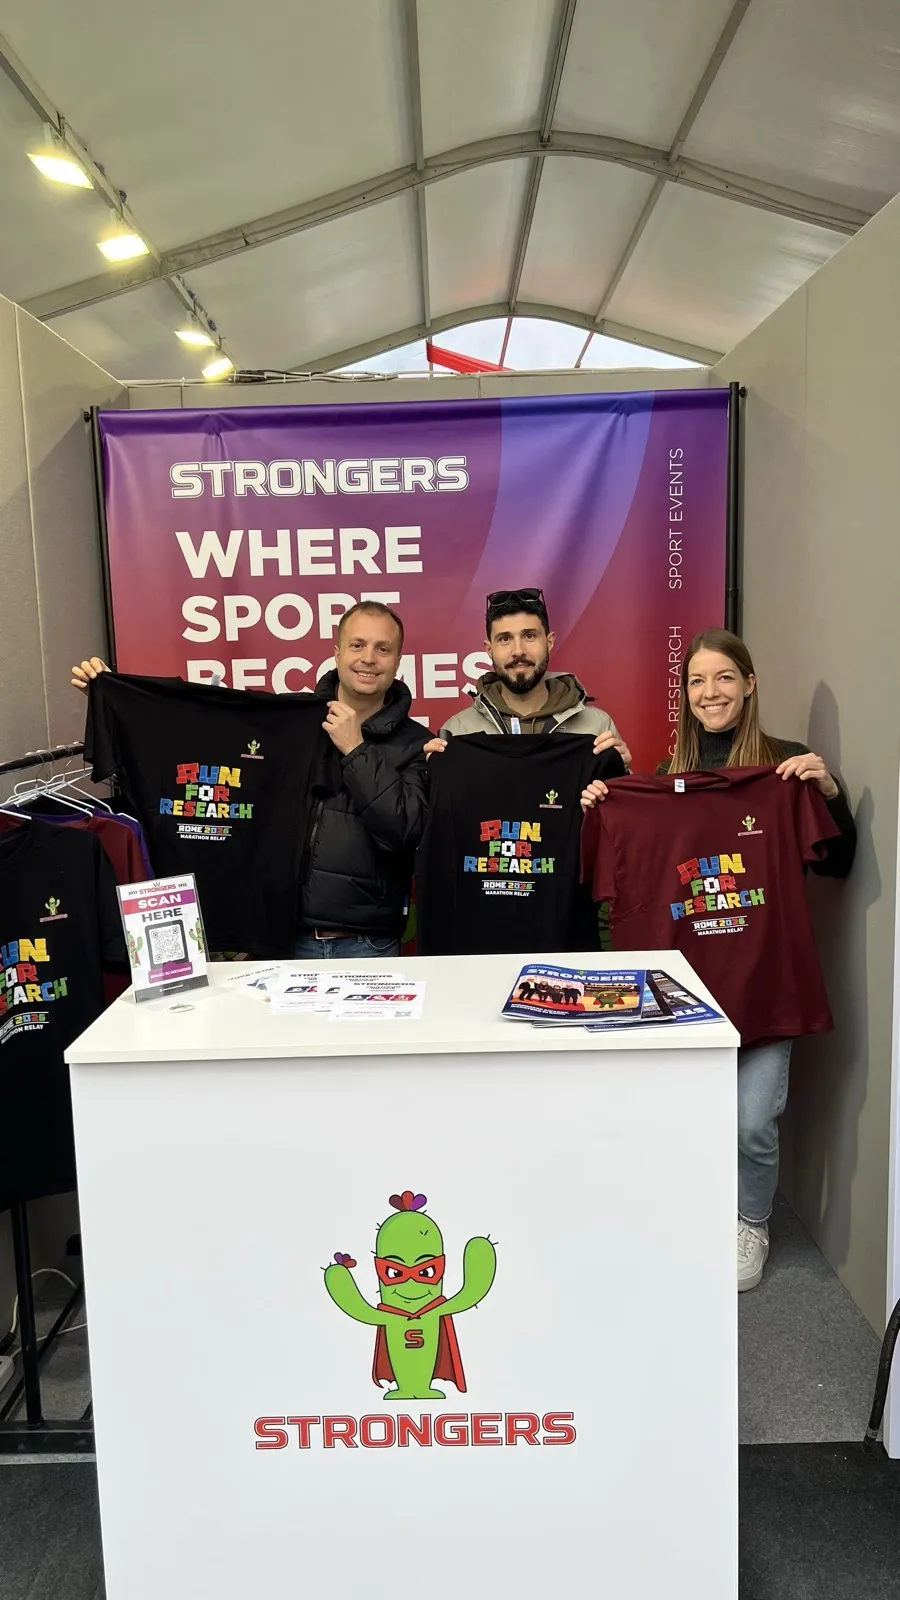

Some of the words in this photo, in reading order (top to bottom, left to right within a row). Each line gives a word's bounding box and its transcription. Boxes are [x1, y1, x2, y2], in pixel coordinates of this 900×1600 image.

[170, 456, 470, 498] STRONGERS
[669, 448, 684, 522] EVENTS
[175, 526, 423, 579] WHERE
[669, 528, 683, 590] SPORT
[181, 591, 400, 643] SPOR
[669, 626, 682, 722] RESEARCH
[176, 763, 241, 788] RUN
[185, 784, 230, 802] FOR
[159, 798, 254, 819] RESEARCH
[178, 825, 202, 833] ROME
[204, 826, 229, 834] 2026
[480, 819, 542, 842] RUN
[489, 840, 532, 857] FOR
[463, 855, 555, 874] RESEARCH
[676, 853, 746, 885] RUN
[139, 884, 177, 895] STRONGERS
[483, 881, 507, 889] ROME
[507, 882, 533, 890] 2026
[690, 875, 738, 897] FOR
[137, 893, 182, 909] SCAN
[670, 888, 766, 921] RESEARCH
[141, 907, 184, 923] HERE
[693, 920, 718, 930] ROME
[719, 917, 746, 927] 2026
[697, 929, 727, 937] MARATHON
[0, 938, 50, 971] UN
[526, 968, 636, 982] STRONGERS
[404, 1329, 425, 1349] S
[253, 1411, 577, 1450] STRONGERS
